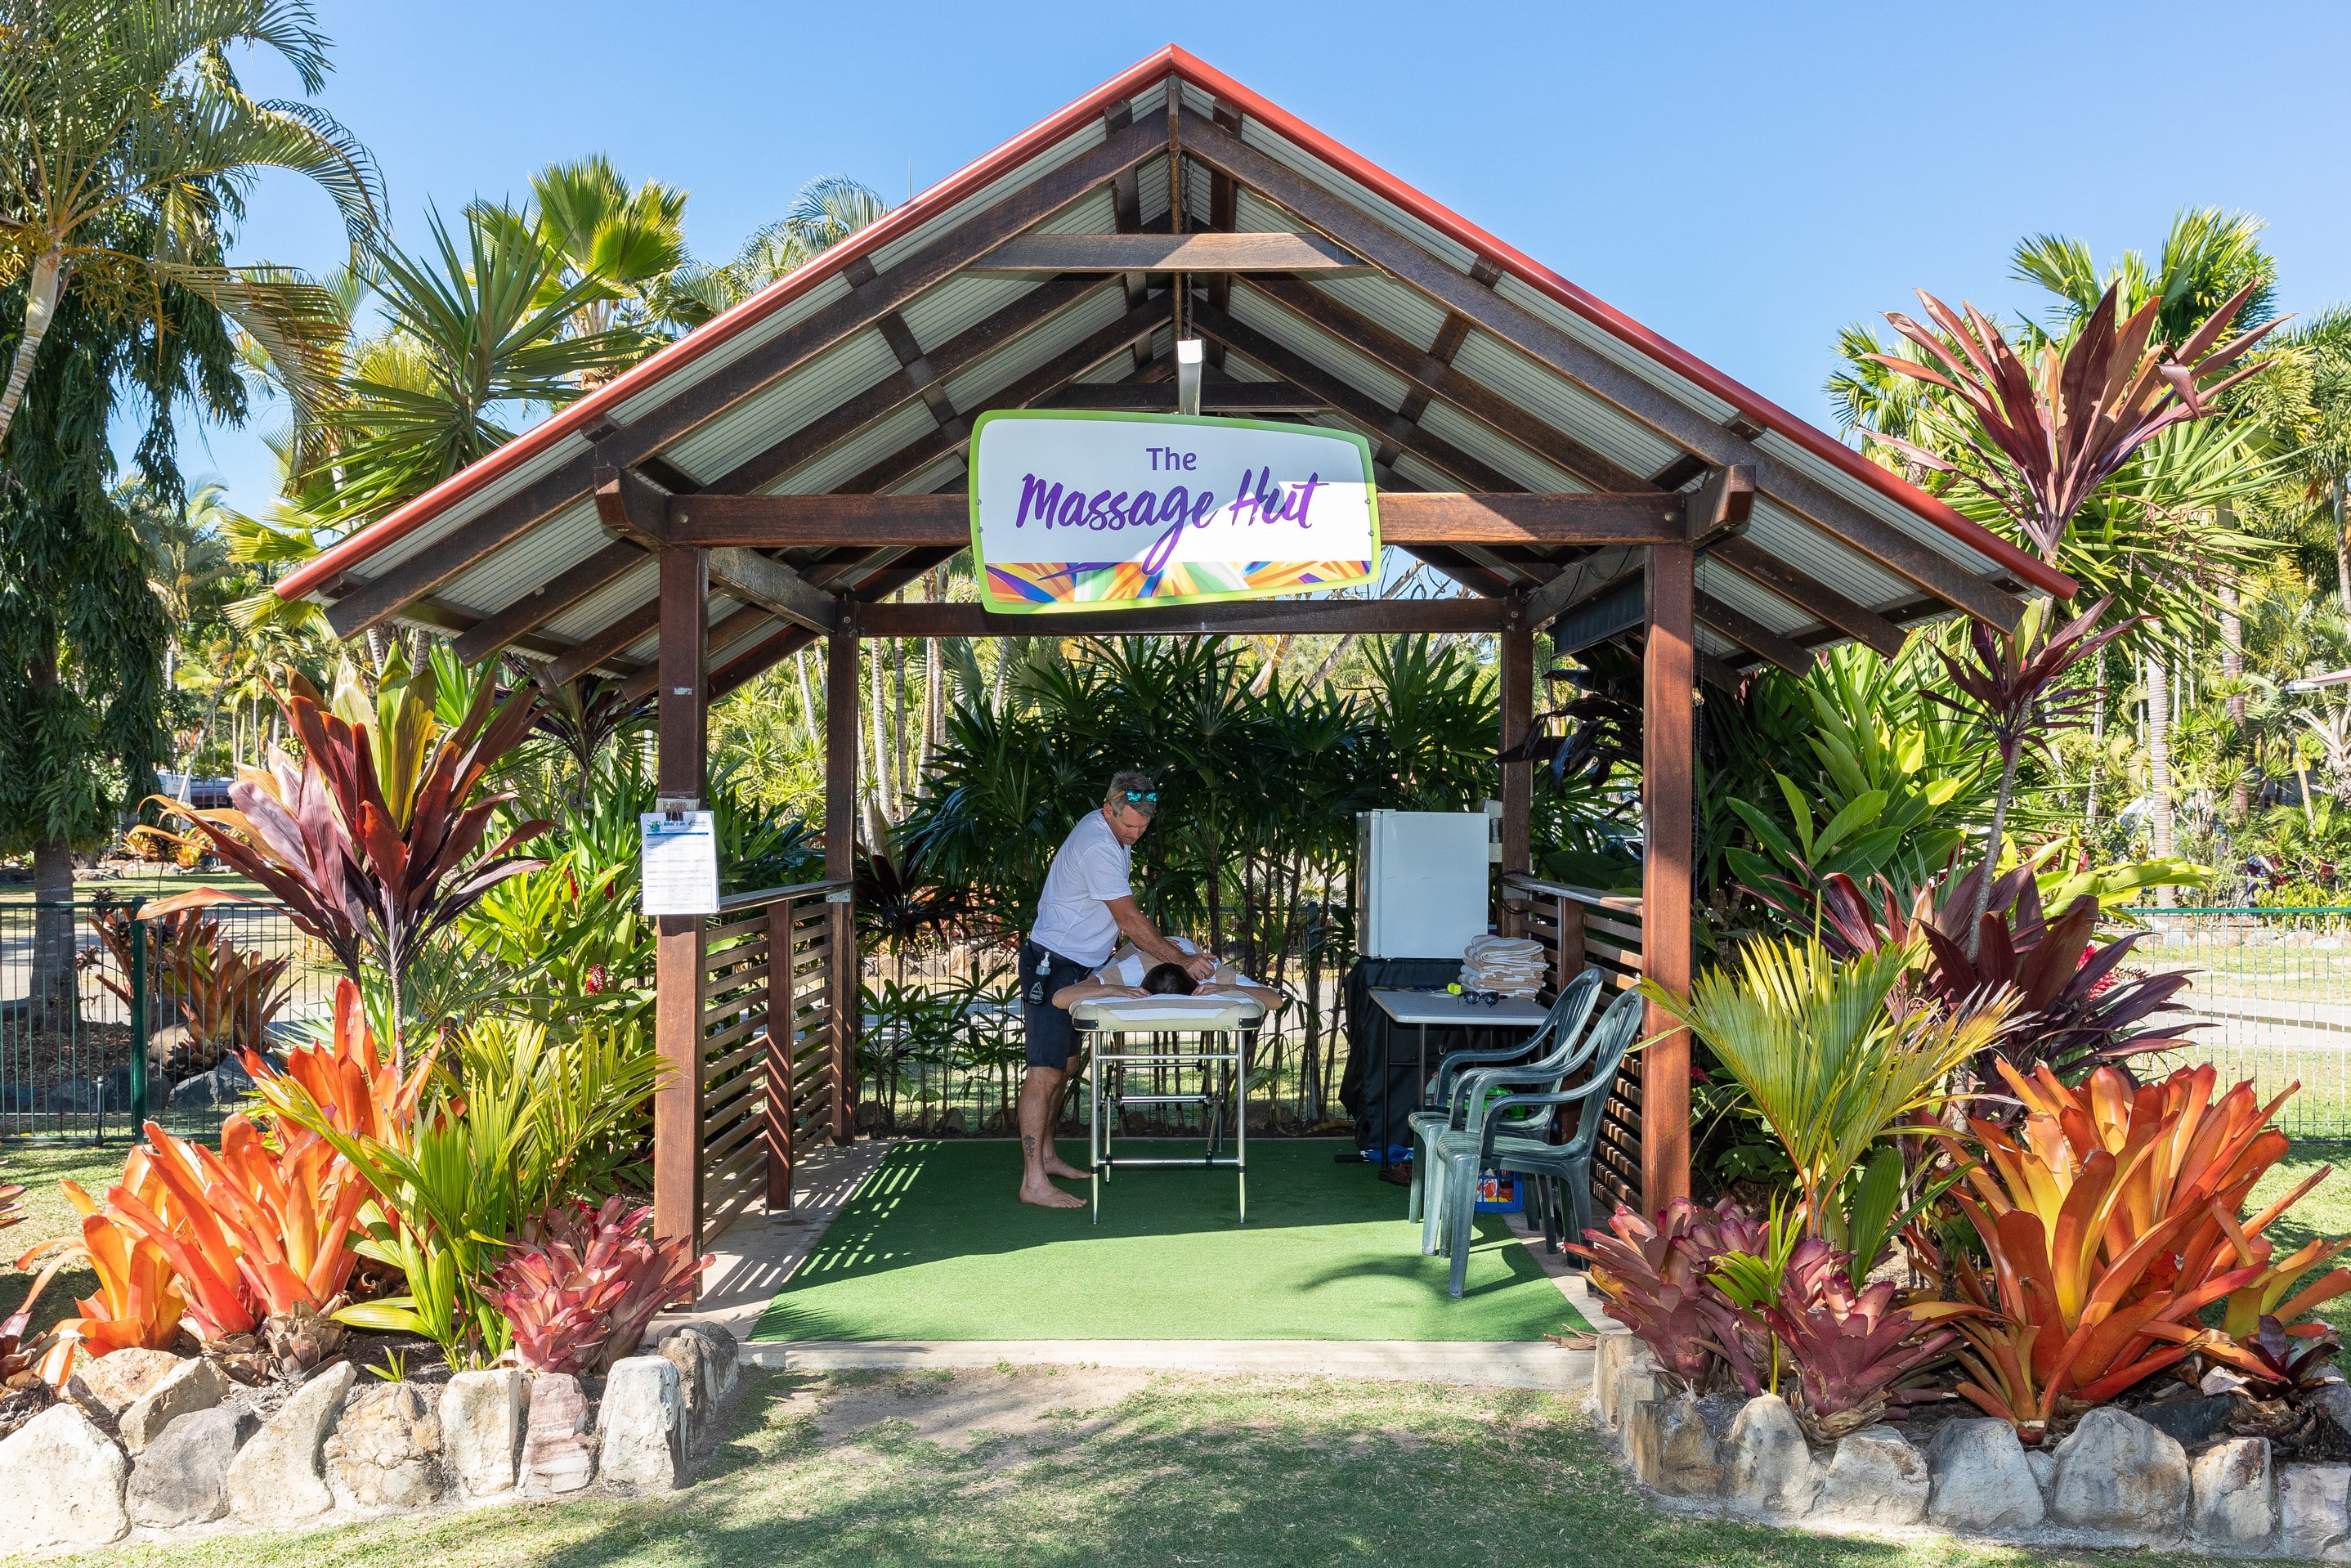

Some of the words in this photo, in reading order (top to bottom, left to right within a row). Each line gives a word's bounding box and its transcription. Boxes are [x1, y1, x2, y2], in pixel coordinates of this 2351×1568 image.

[1146, 447, 1197, 471] The
[1015, 473, 1218, 576] Massage
[1229, 466, 1330, 529] Hut
